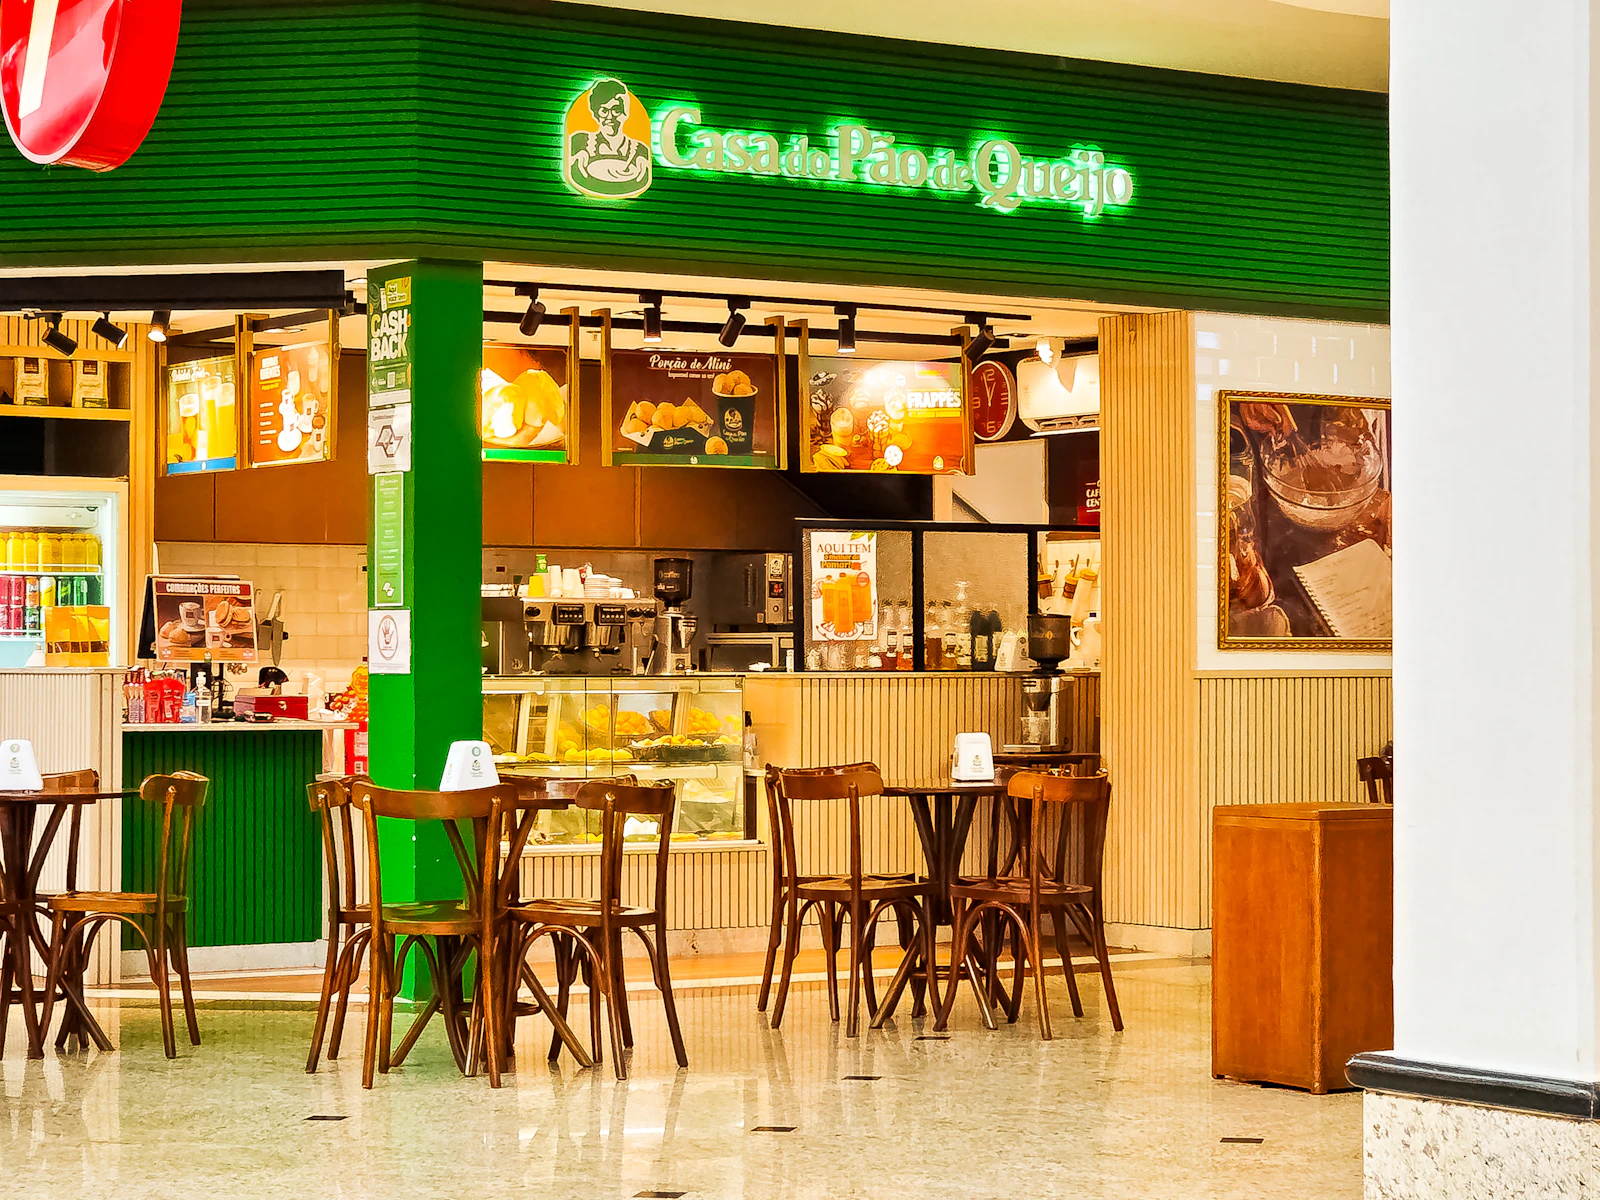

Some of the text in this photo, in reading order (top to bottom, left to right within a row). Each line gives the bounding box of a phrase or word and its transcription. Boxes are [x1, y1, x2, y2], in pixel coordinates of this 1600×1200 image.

[661, 108, 1133, 216] Casa do Pão de Queijo
[370, 309, 408, 338] CASH
[370, 333, 408, 362] BACK
[649, 354, 733, 371] Porção de Mini
[907, 387, 962, 409] FRAPPÉS
[816, 543, 871, 554] AQUI TEM
[166, 582, 241, 594] COMBINAÇÕES PERFEITAS
